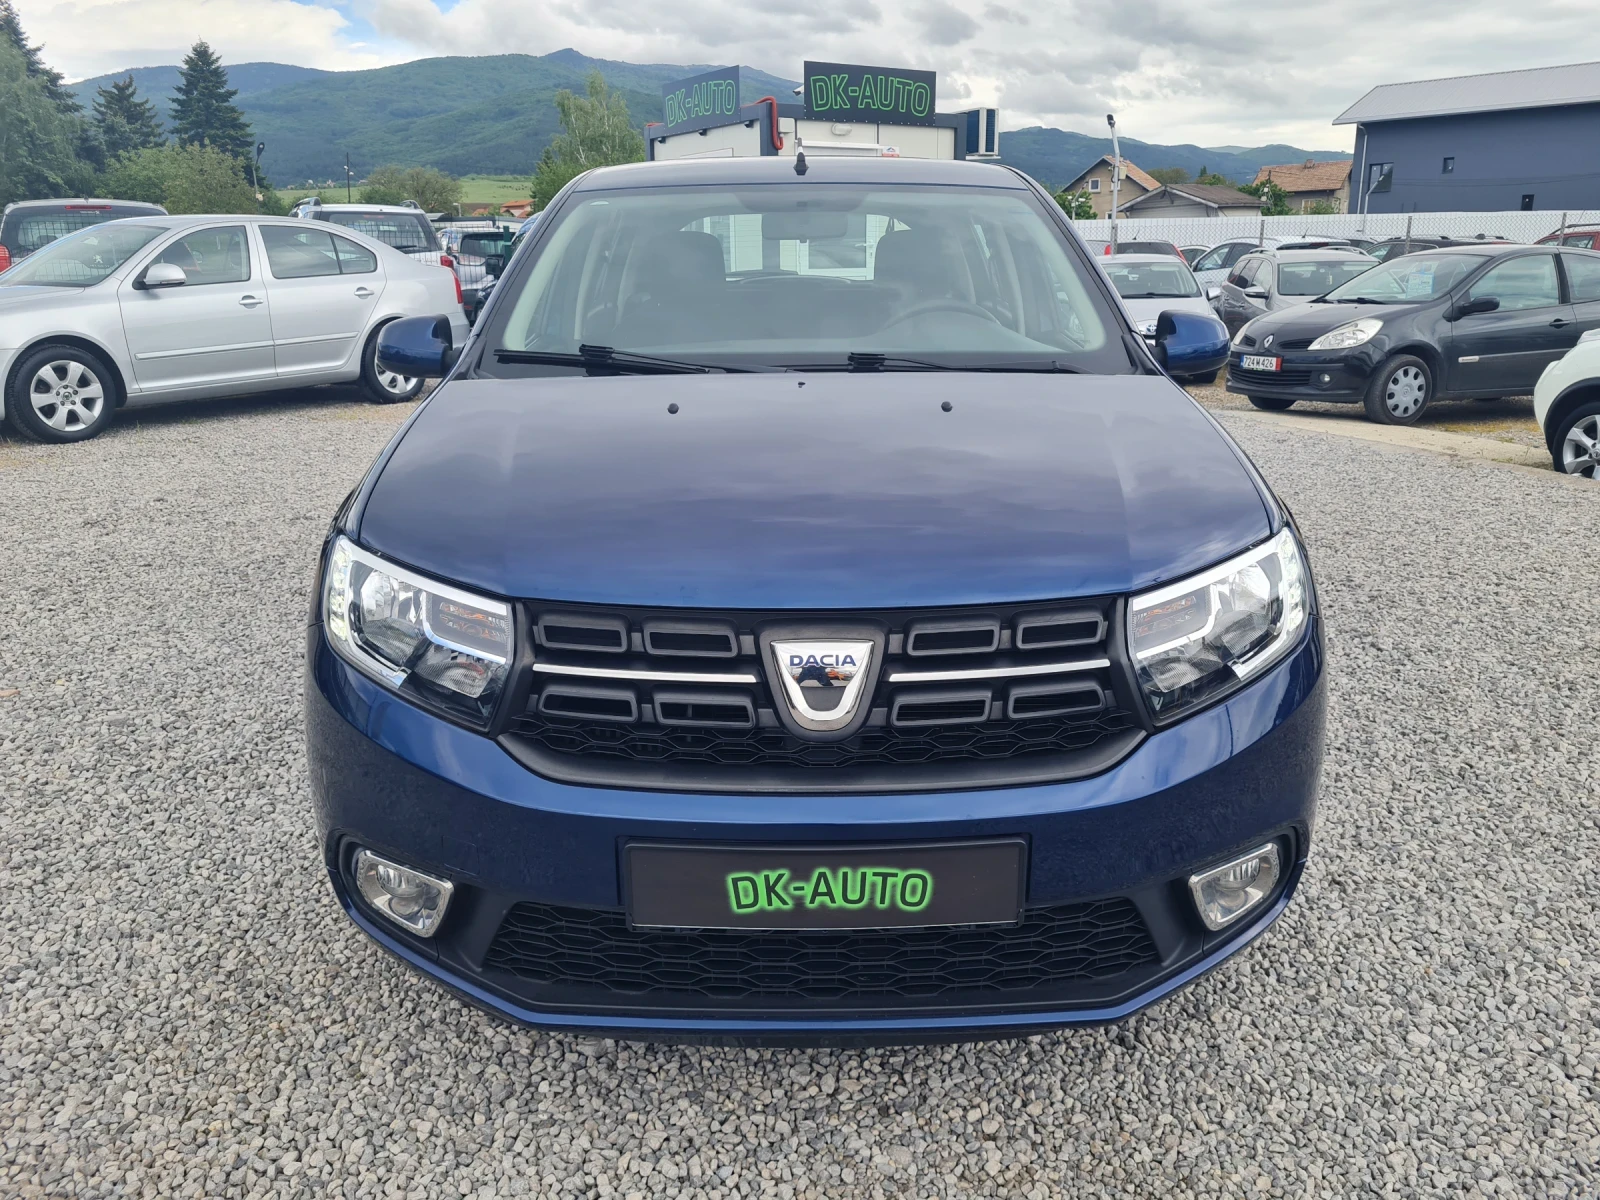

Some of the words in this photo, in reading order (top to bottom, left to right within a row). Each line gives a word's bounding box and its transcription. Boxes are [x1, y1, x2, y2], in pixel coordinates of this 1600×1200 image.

[665, 80, 736, 128] DK-AUTO
[810, 74, 930, 117] DK-AUTO
[789, 654, 857, 667] DACIA
[730, 869, 931, 911] DK-AUTO
